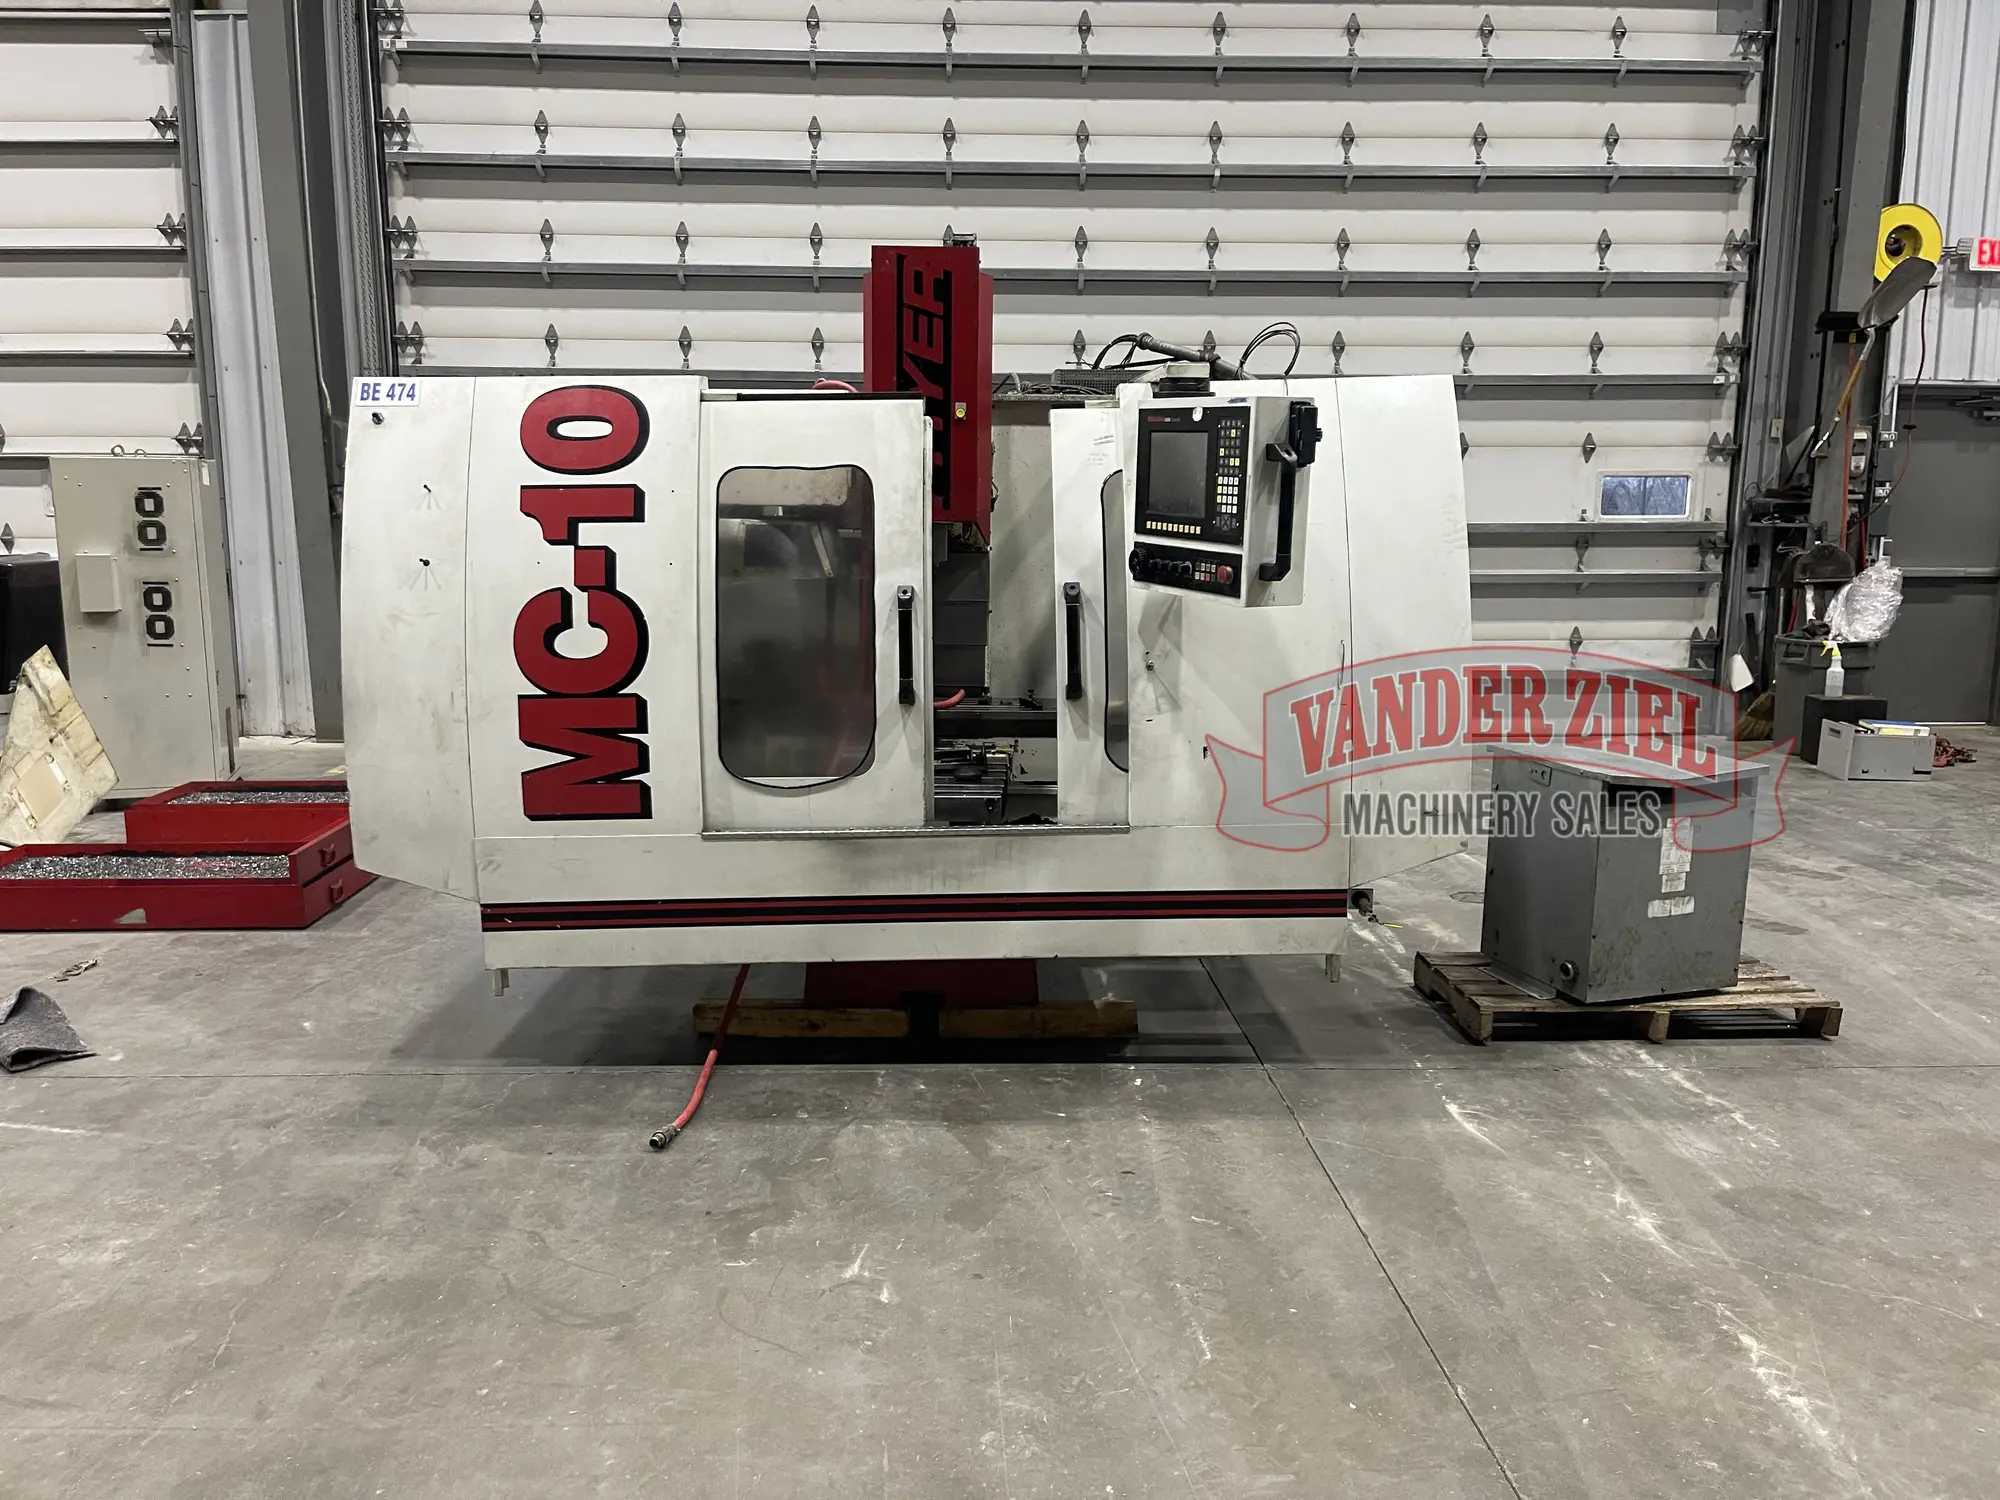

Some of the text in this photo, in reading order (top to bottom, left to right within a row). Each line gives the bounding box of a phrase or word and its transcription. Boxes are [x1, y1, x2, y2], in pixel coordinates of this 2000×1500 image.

[360, 382, 416, 402] BE 474
[513, 384, 652, 821] MC-10
